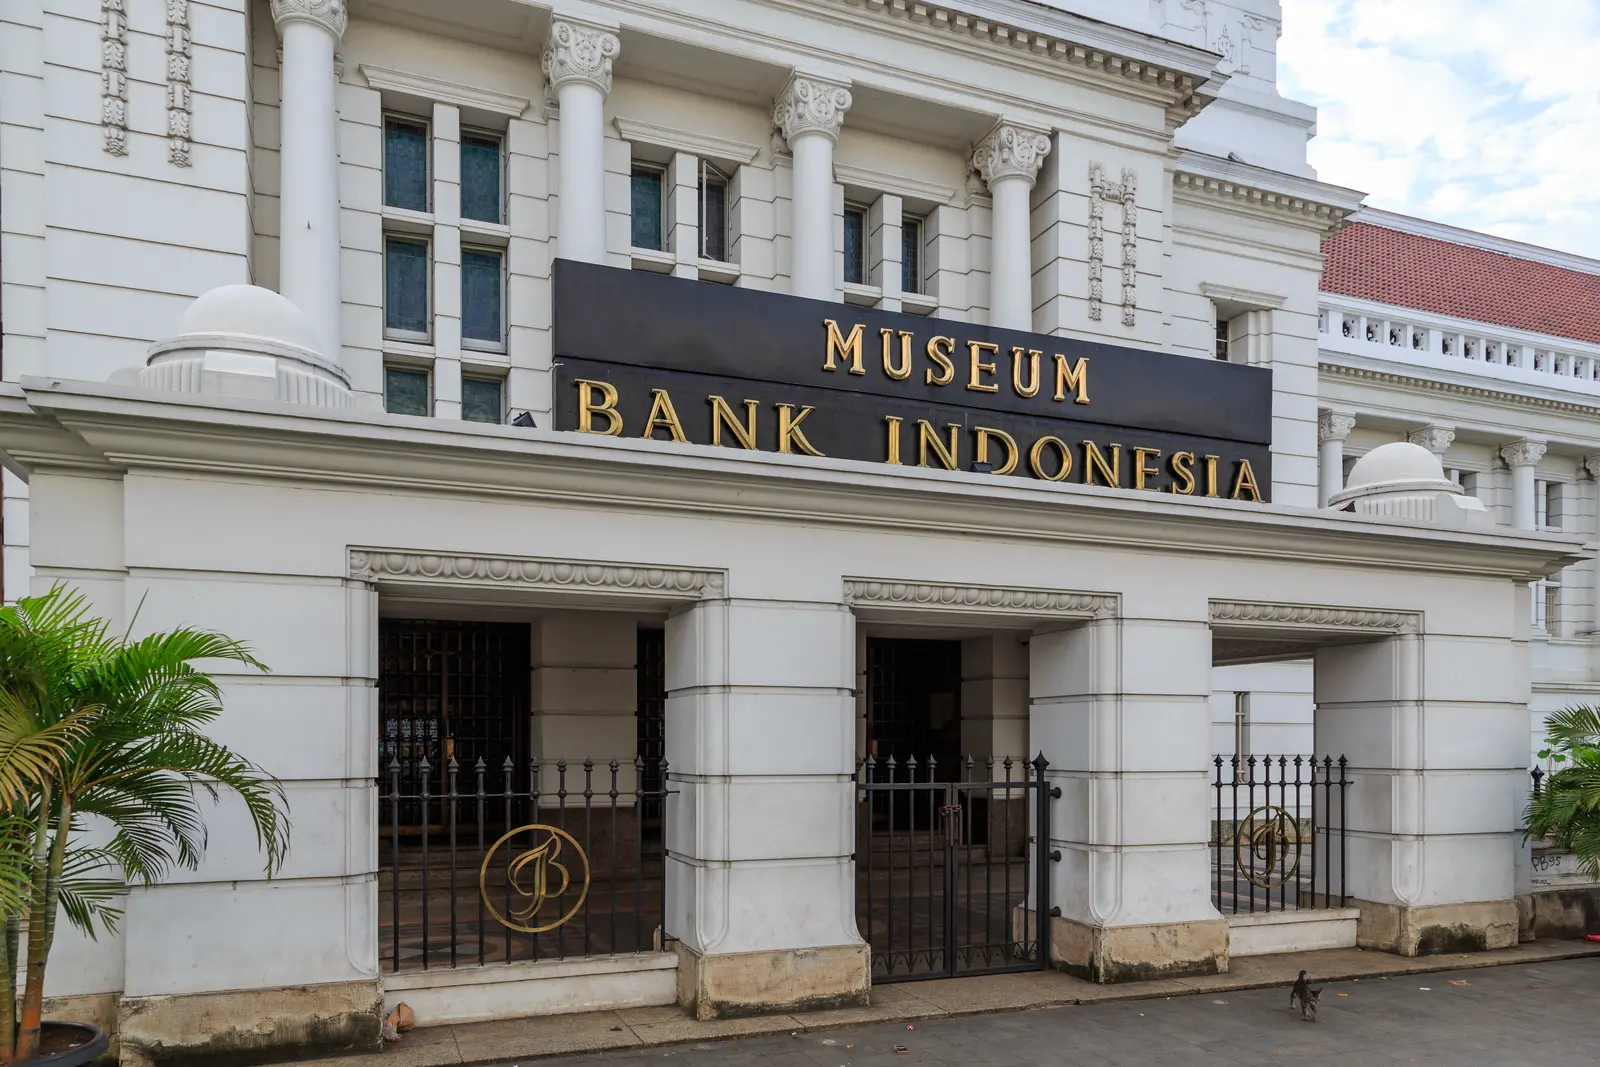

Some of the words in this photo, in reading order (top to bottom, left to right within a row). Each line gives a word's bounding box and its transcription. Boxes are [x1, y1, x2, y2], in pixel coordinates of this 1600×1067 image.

[823, 319, 1091, 405] MUSEUM
[575, 378, 826, 456] BANK
[883, 415, 1263, 502] INDONESIA
